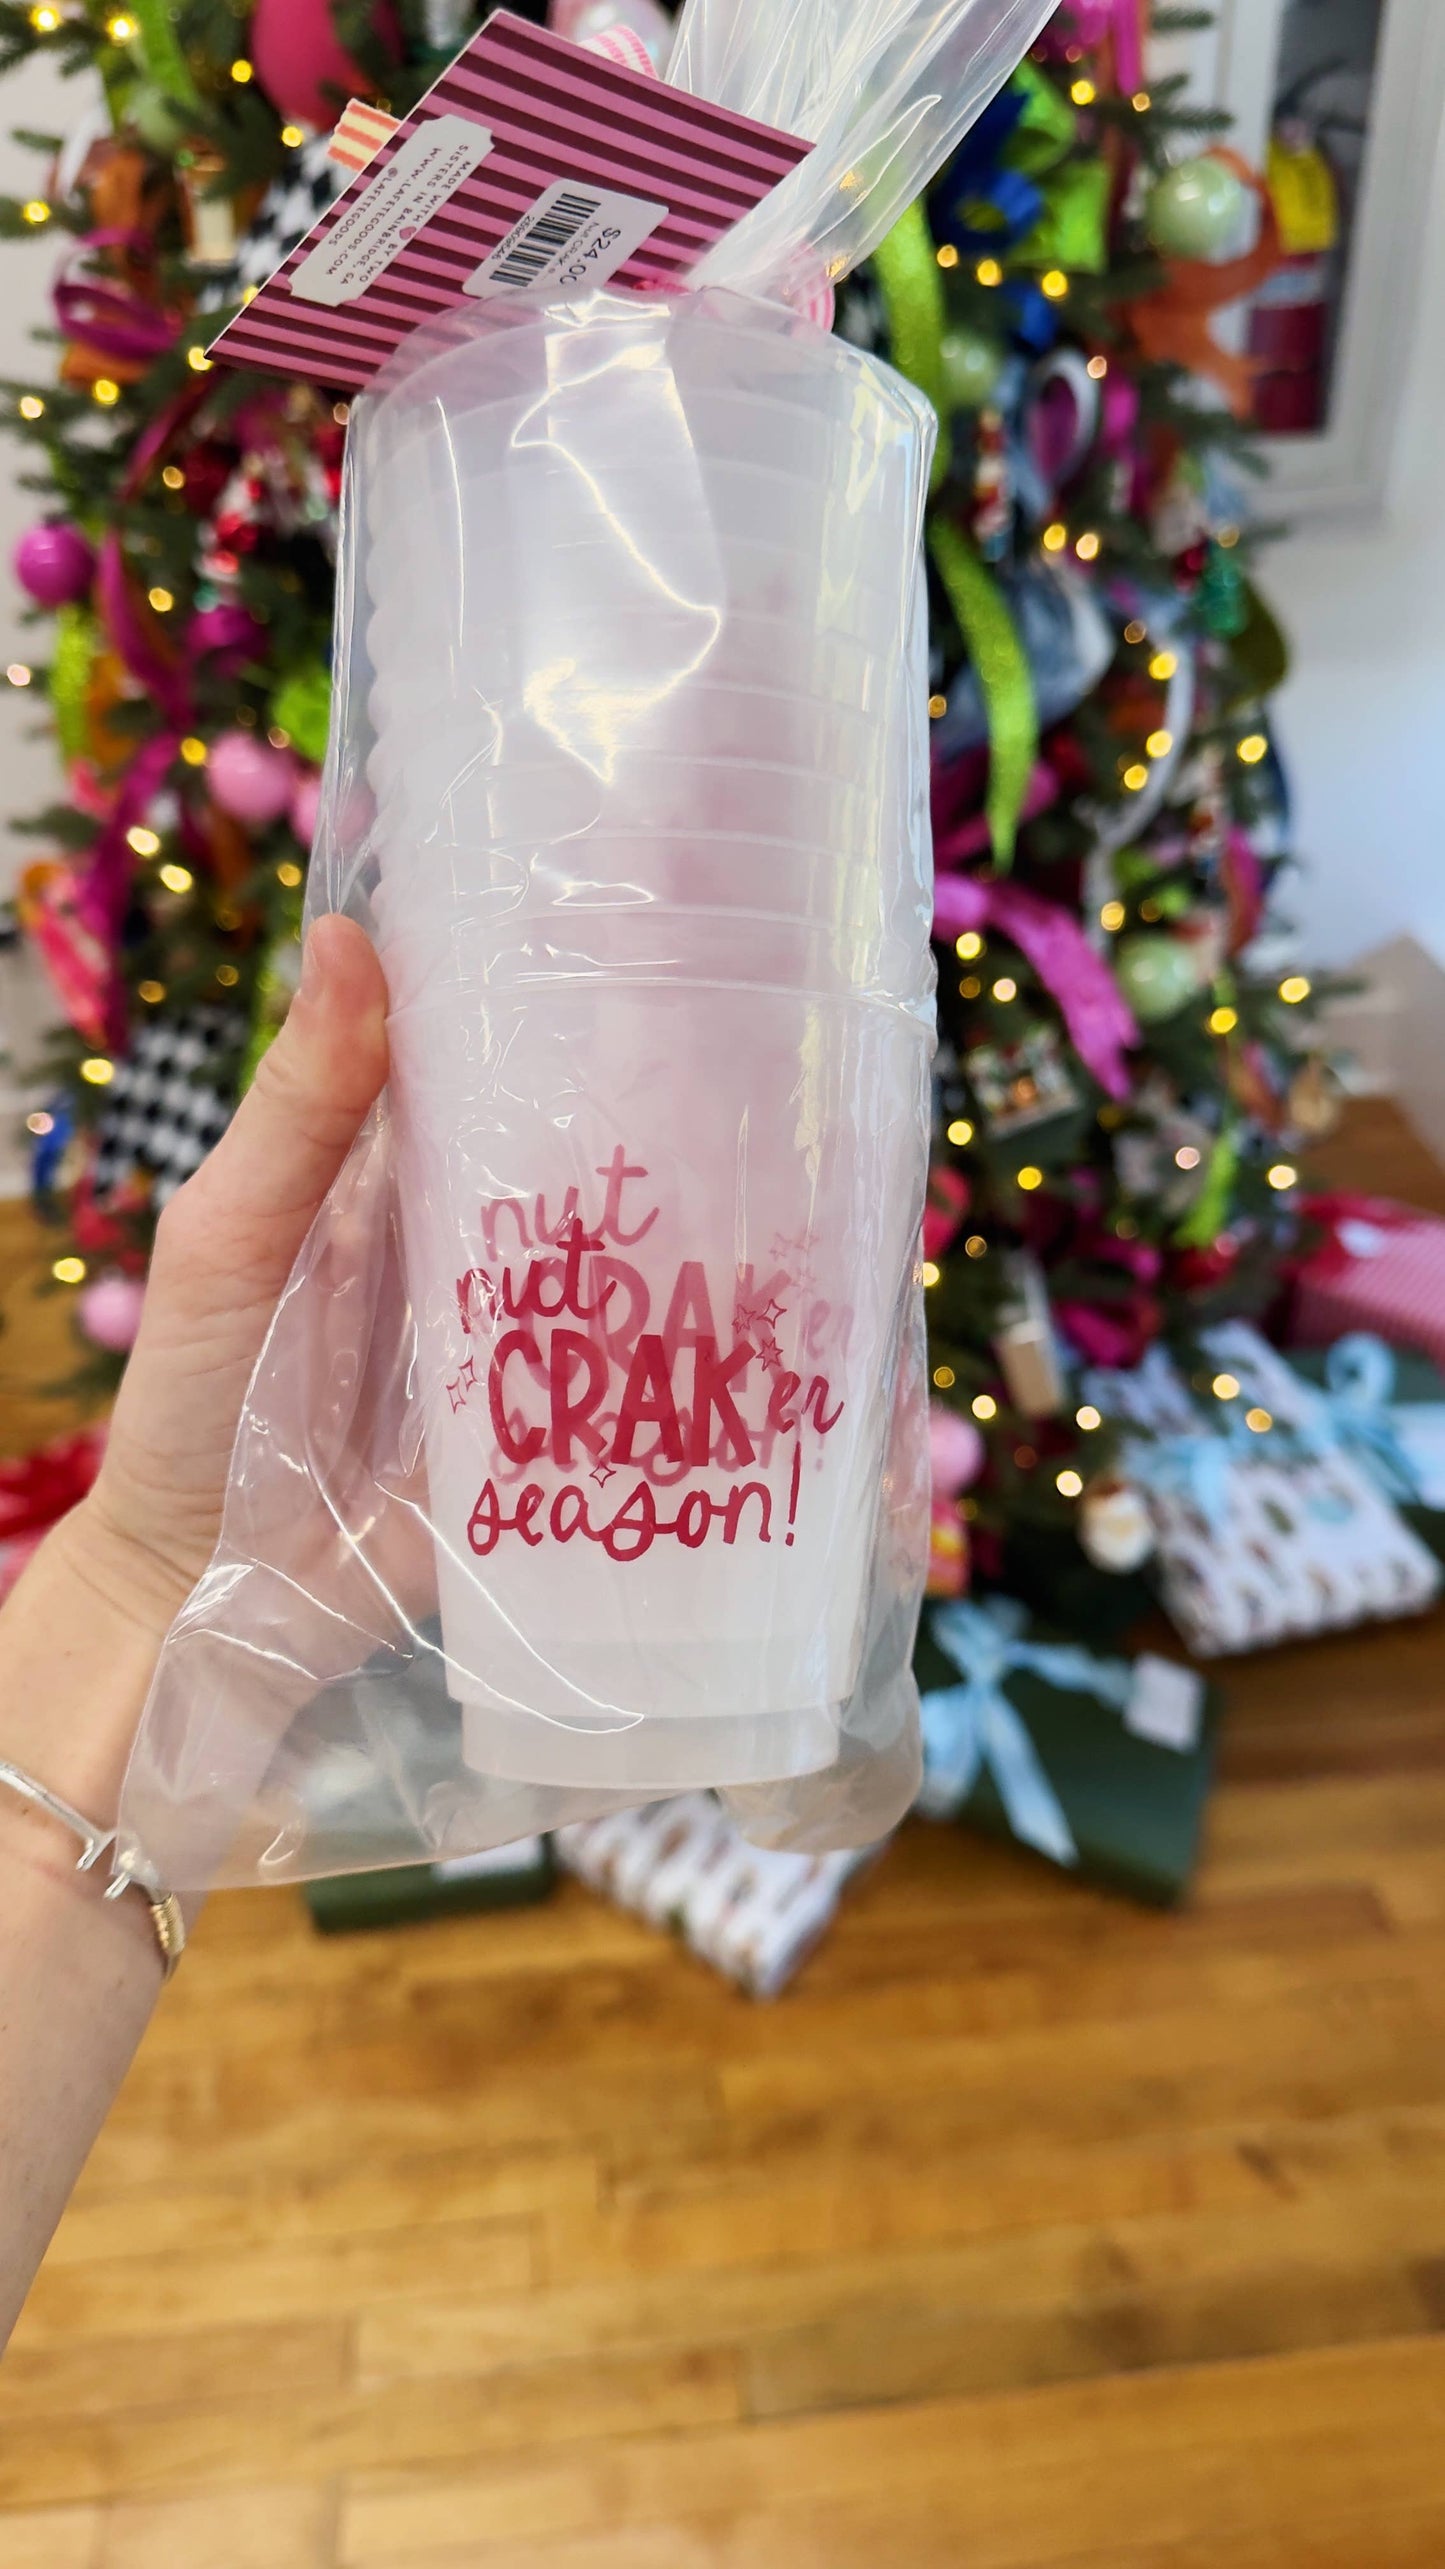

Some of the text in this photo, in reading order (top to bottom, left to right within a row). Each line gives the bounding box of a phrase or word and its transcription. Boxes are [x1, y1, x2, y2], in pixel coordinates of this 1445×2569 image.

[325, 147, 443, 275] WWW.LAFETEGOODS.COM
[328, 166, 399, 246] @LAFETEGOODS
[339, 144, 469, 285] SISTERS IN BAINBRIDGE, GA
[358, 160, 472, 283] MADE WITH BY TWO
[558, 226, 622, 289] $24.00
[481, 1144, 660, 1262] nut
[456, 1217, 617, 1335] nut
[488, 1328, 844, 1467] CRAKer
[467, 1441, 801, 1562] season!
